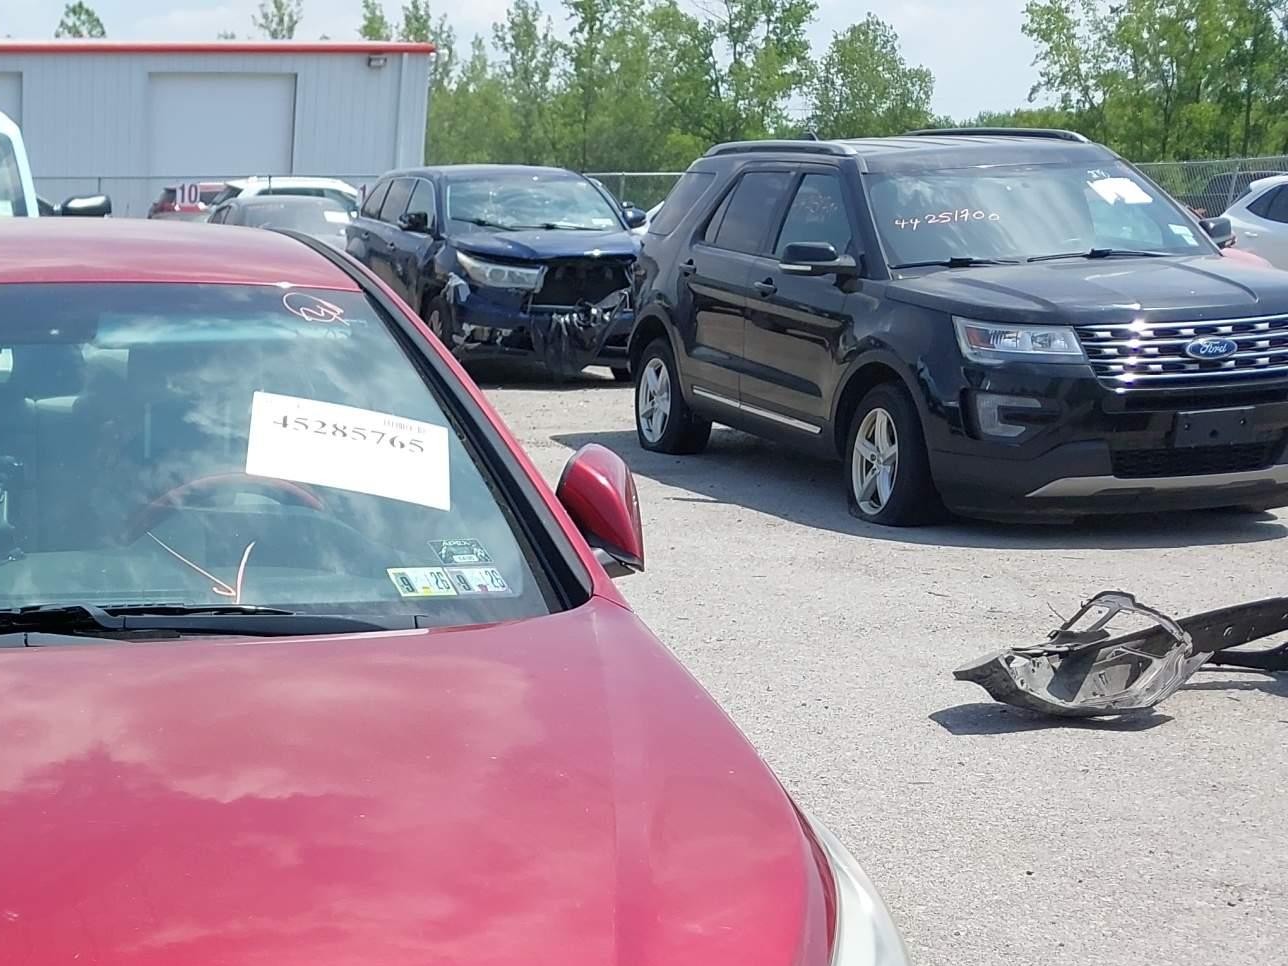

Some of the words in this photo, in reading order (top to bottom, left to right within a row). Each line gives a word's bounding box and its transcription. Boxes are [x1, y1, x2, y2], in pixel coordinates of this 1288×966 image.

[177, 183, 200, 204] 10
[1199, 339, 1228, 354] Ford
[272, 415, 425, 453] 45285765
[399, 575, 416, 593] 9
[456, 574, 472, 591] 9
